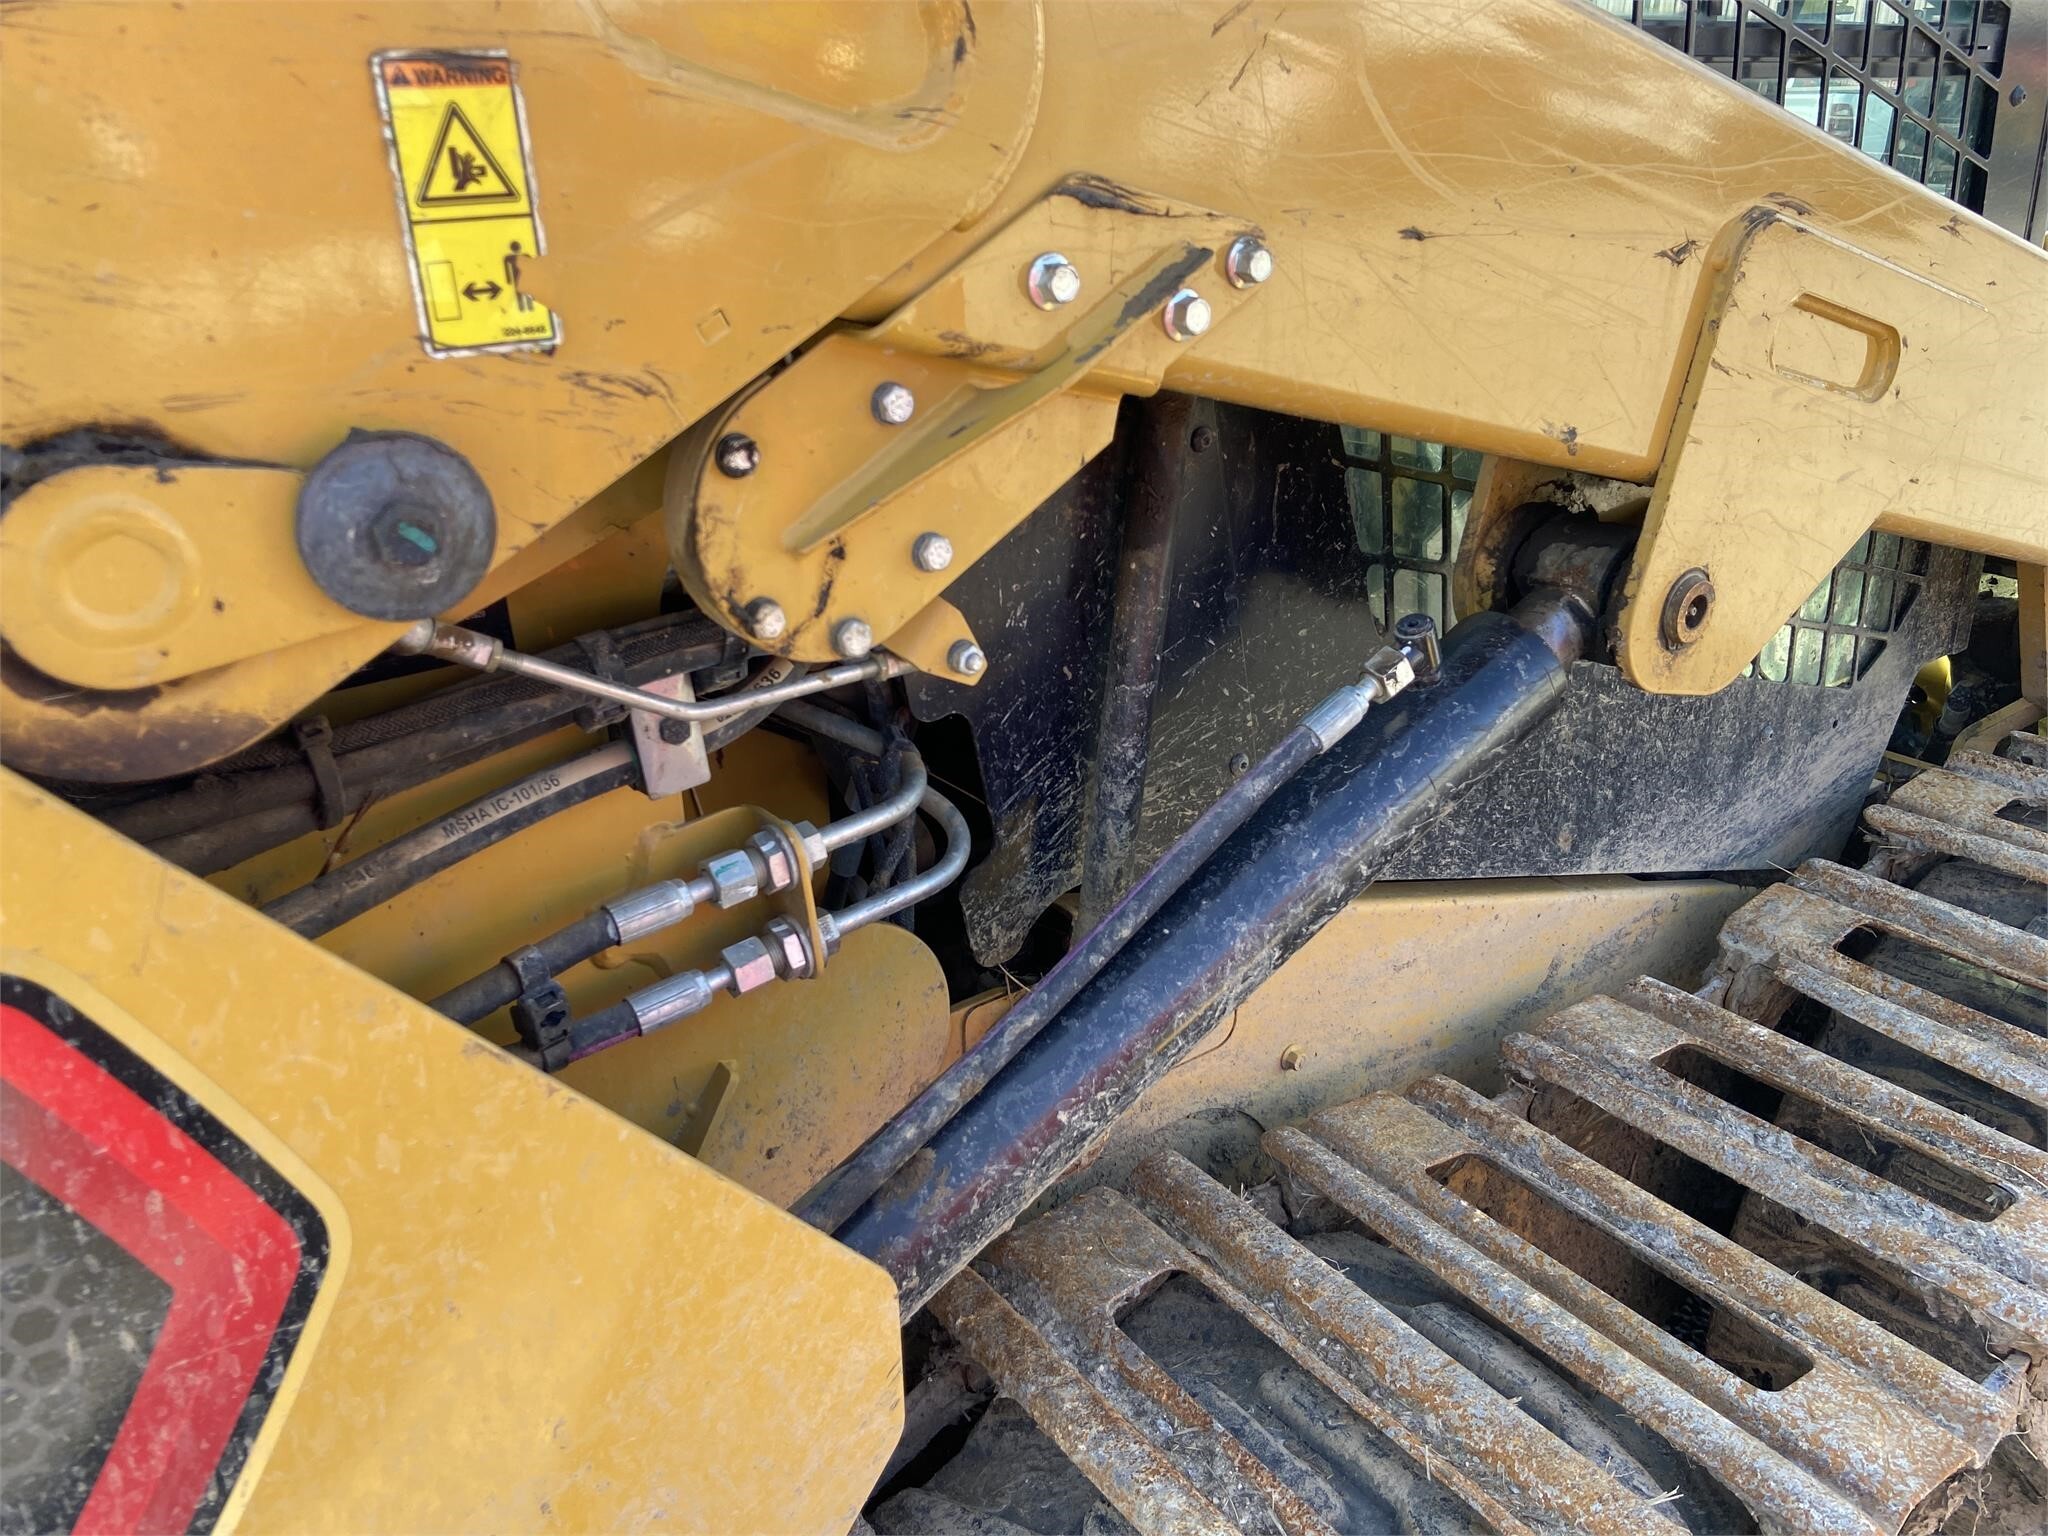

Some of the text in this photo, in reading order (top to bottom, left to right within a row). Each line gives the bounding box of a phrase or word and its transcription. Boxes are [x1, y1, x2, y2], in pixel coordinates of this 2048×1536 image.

[412, 64, 508, 86] WARNING
[441, 774, 561, 838] MSHA IC-101/36
